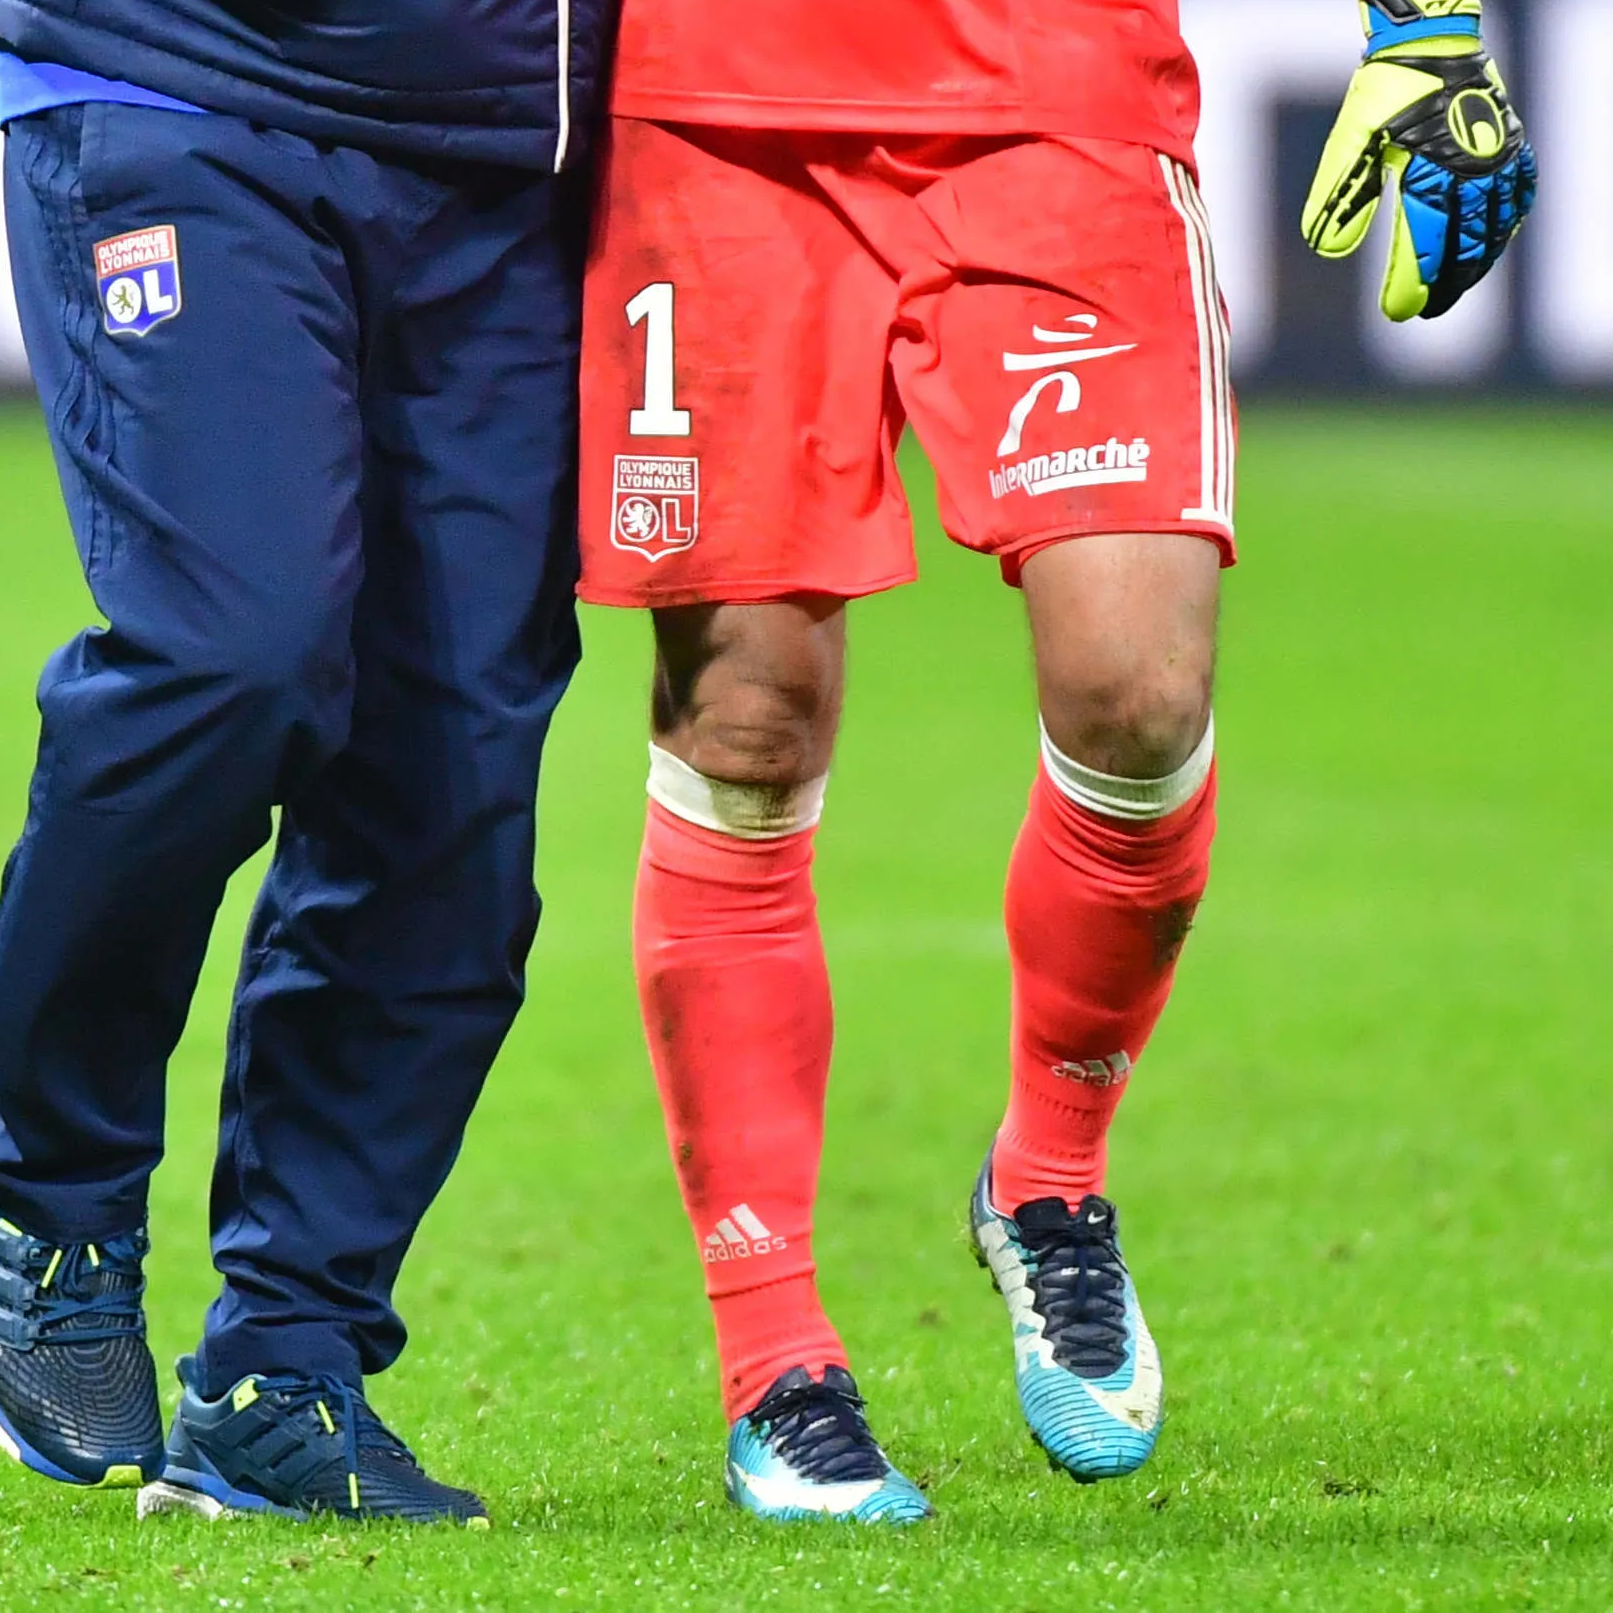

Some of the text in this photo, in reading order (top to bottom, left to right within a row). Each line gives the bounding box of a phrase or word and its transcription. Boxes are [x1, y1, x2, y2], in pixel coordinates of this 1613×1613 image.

[98, 231, 168, 260] OLYMPIQUE
[100, 244, 171, 275] LYONNAIS
[624, 282, 691, 436] 1
[619, 461, 692, 476] OLYMPIQUE
[619, 474, 692, 490] LYONNAIS
[704, 1235, 787, 1263] adidas
